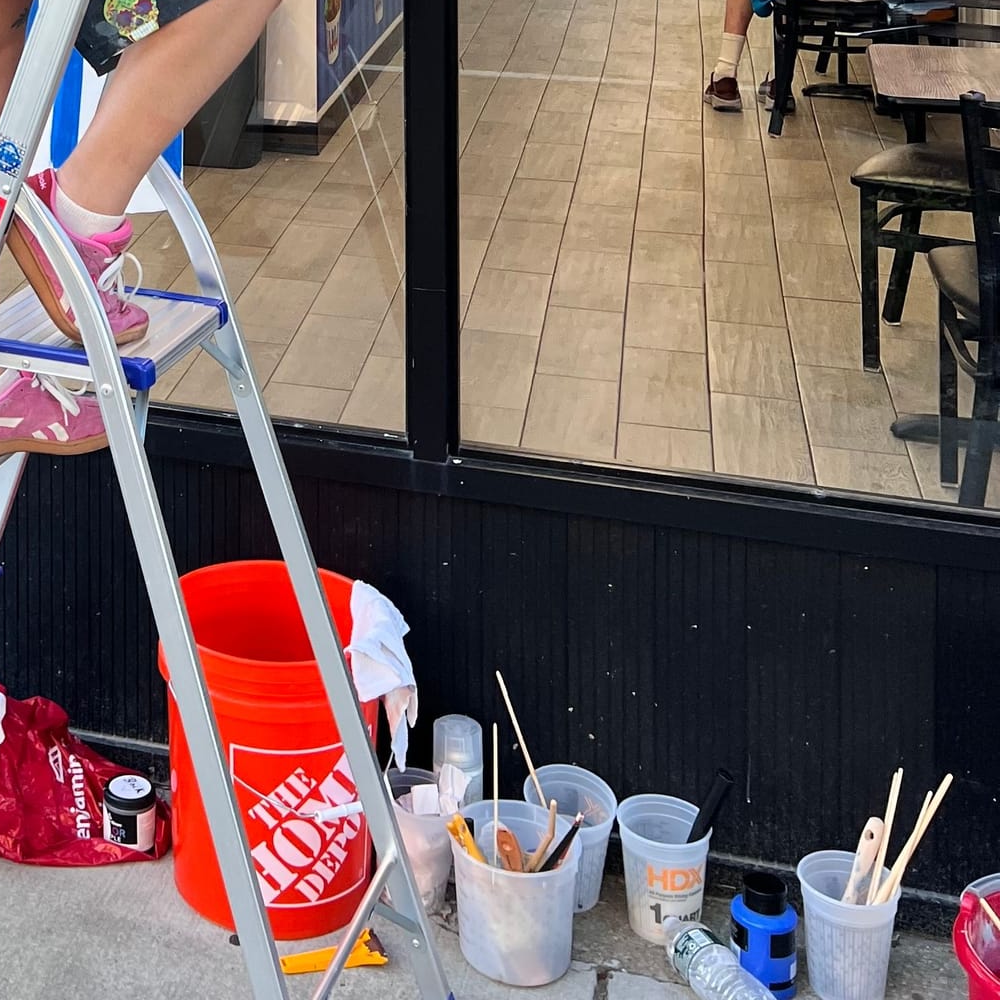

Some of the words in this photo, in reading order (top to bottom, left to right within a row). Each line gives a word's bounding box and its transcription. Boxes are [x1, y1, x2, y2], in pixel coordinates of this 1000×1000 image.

[248, 767, 318, 830] THE
[250, 752, 360, 905] HOM
[294, 812, 362, 903] DEPO
[647, 864, 702, 892] HDX
[650, 903, 662, 924] 1
